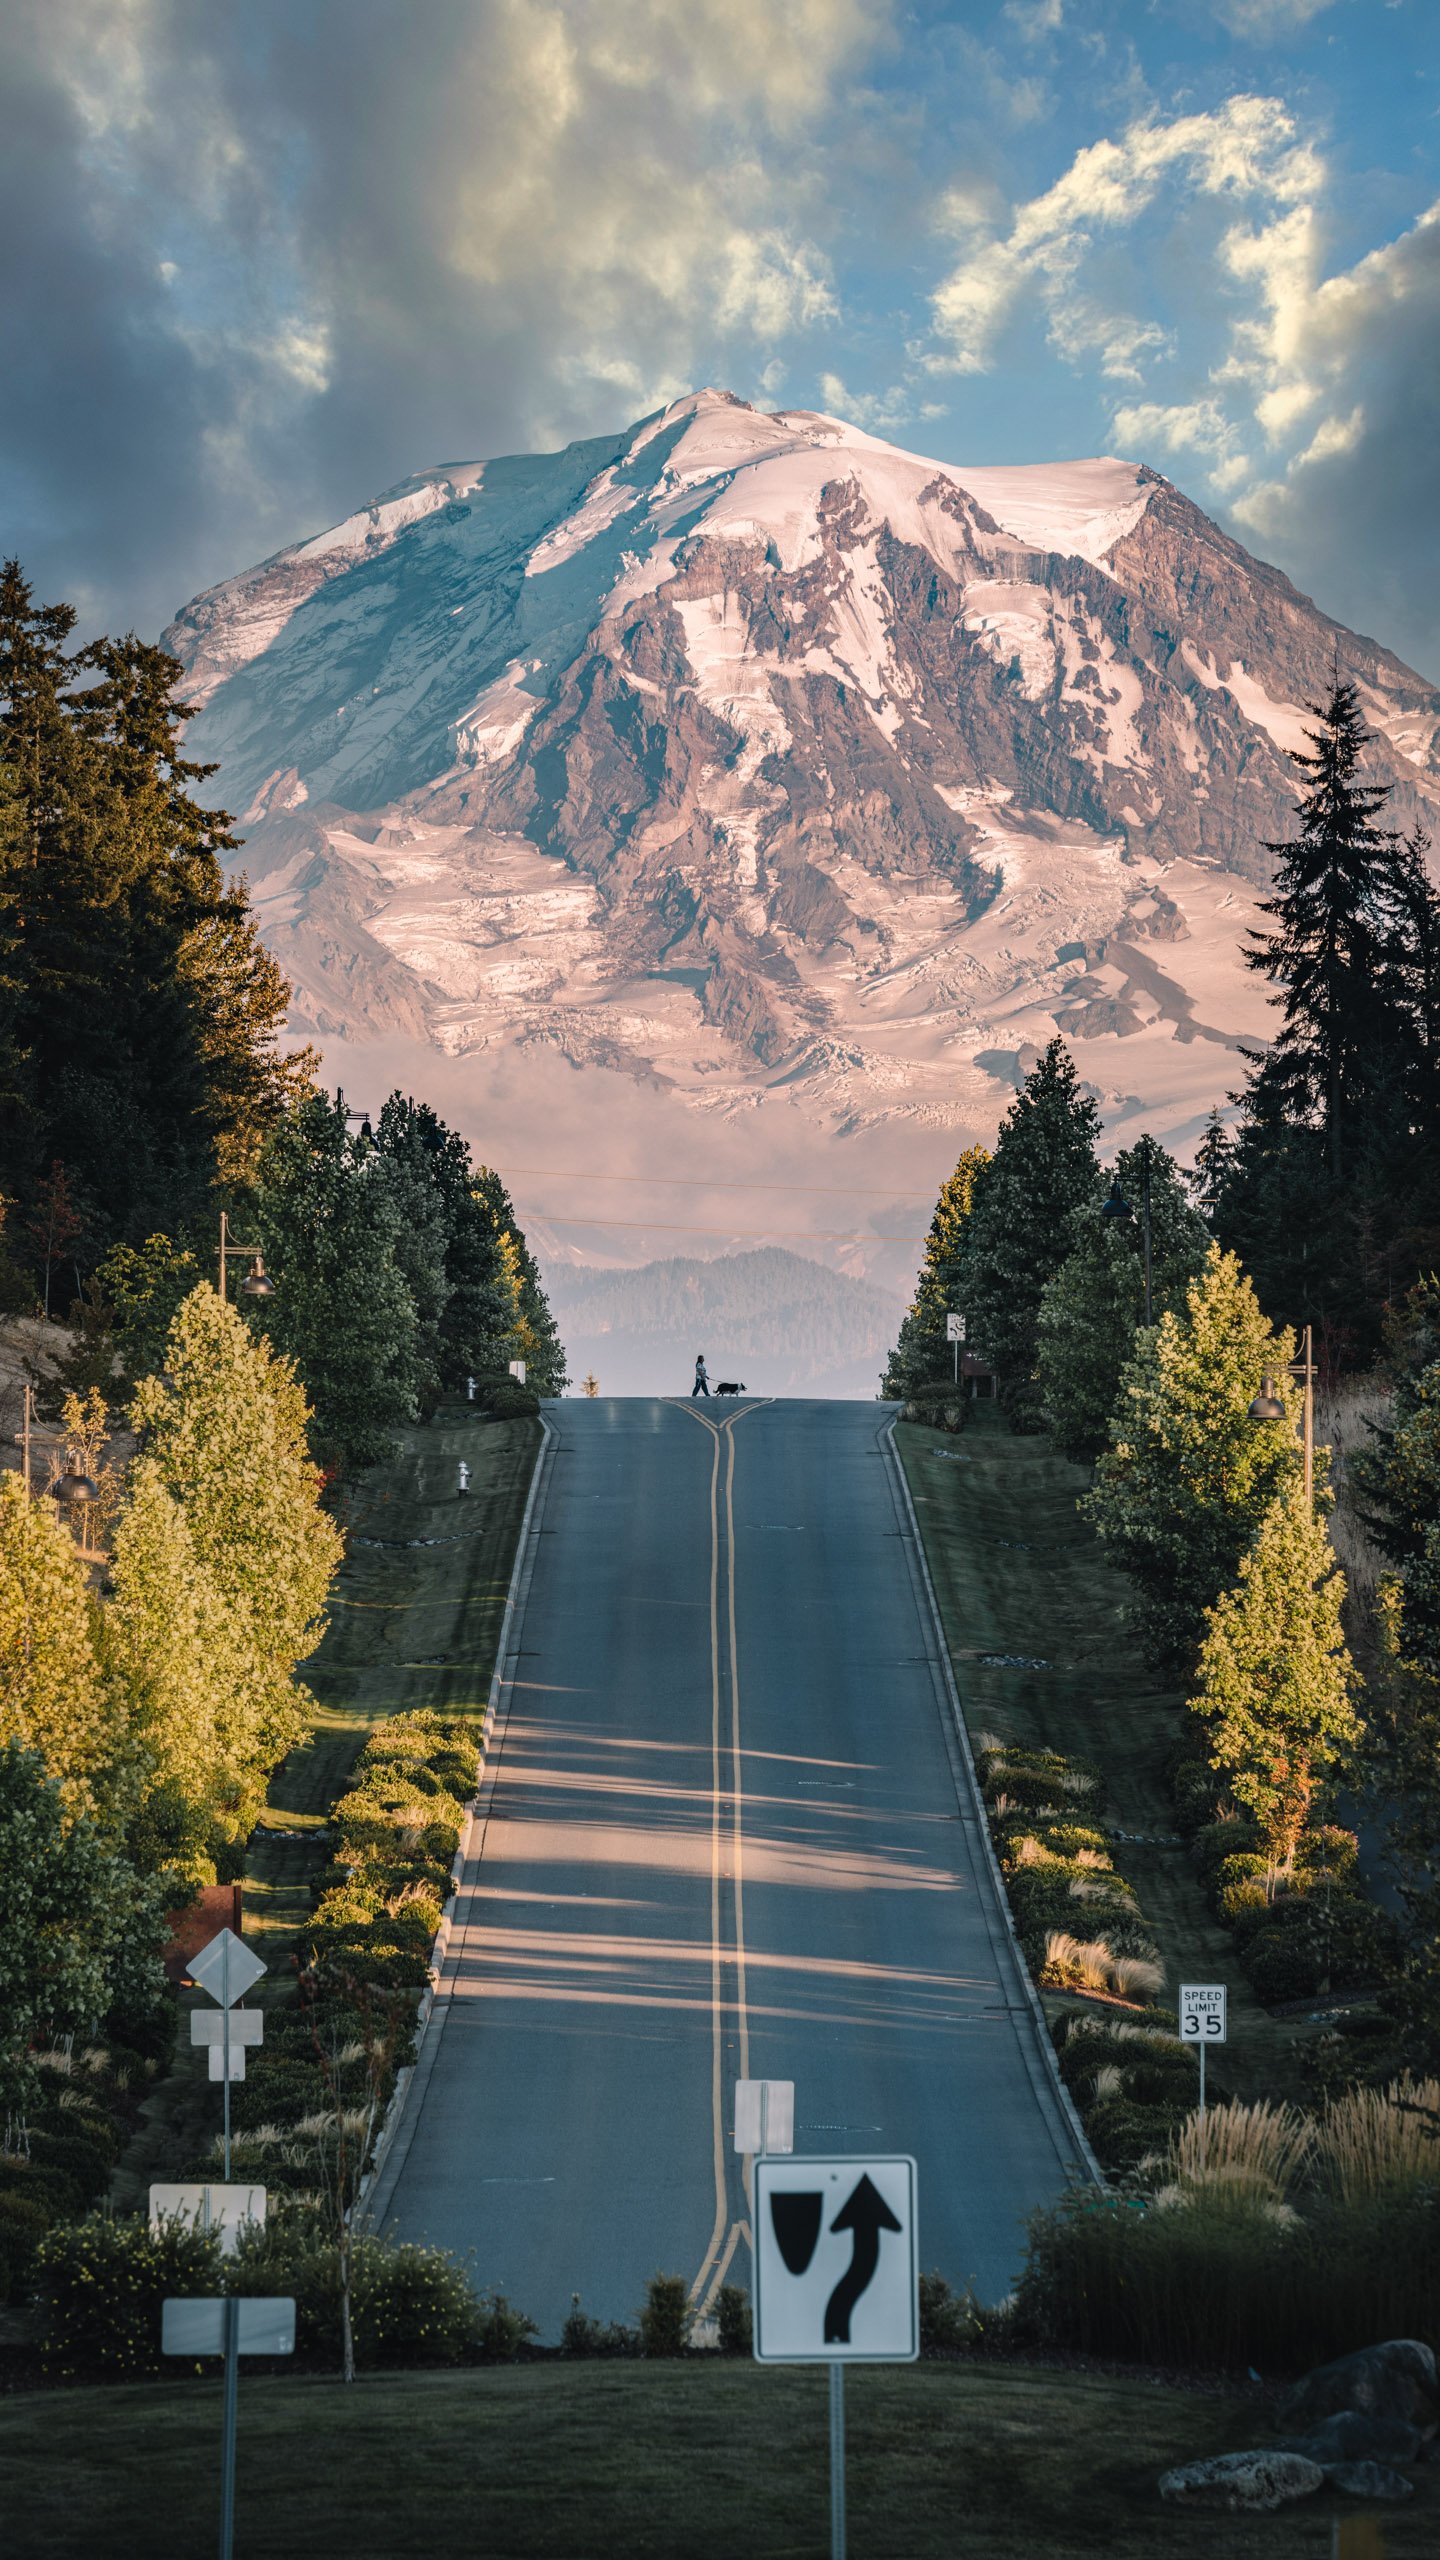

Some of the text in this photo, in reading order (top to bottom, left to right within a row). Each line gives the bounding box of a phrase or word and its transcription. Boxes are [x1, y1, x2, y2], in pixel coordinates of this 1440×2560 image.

[1184, 1992, 1222, 2001] SPEED
[1188, 2003, 1217, 2012] LIMIT
[1184, 2015, 1222, 2035] 35
